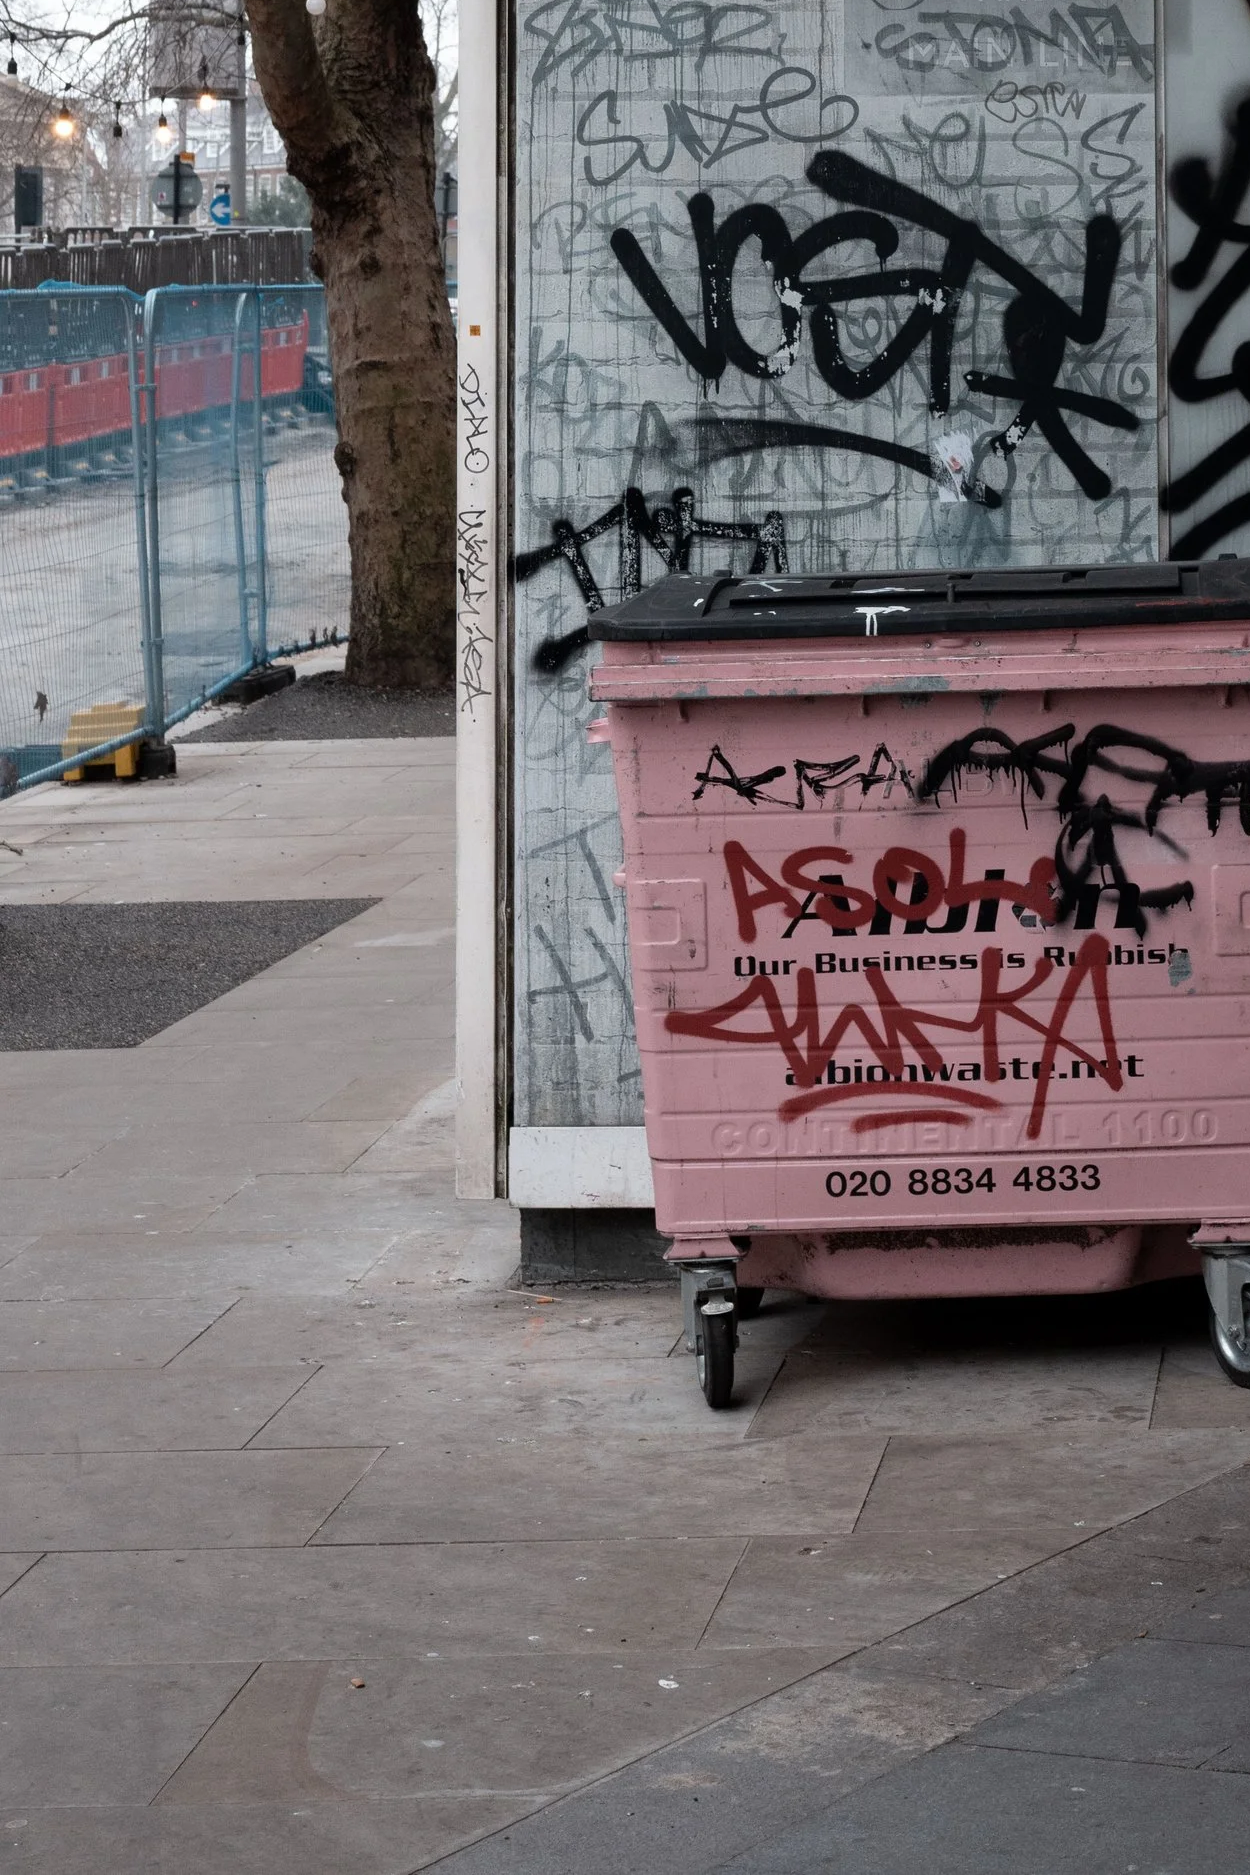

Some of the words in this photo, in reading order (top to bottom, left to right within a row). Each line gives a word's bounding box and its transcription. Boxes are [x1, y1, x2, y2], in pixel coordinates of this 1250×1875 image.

[908, 36, 1015, 68] MAIN
[1040, 36, 1133, 68] LINE
[734, 955, 798, 976] Our
[815, 952, 978, 975] Business
[996, 947, 1026, 969] is
[1101, 1107, 1218, 1147] 1100
[826, 1170, 892, 1197] 020
[907, 1167, 997, 1194] 8834
[1012, 1164, 1101, 1193] 4833
